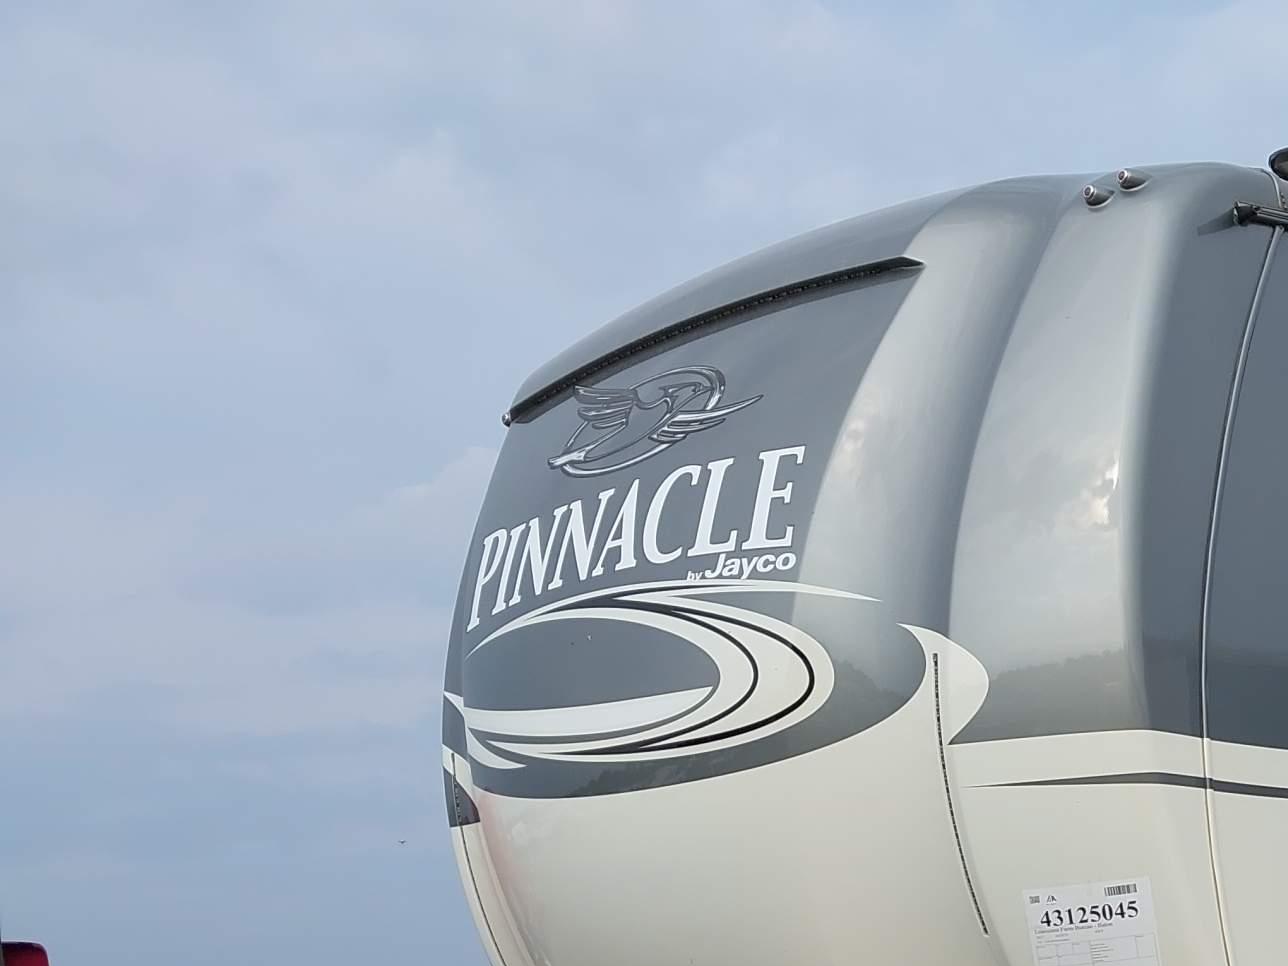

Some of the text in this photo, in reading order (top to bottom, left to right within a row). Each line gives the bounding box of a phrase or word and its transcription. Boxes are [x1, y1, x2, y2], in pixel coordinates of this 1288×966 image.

[466, 445, 807, 633] PINNACLE
[686, 552, 797, 582] by Jayco
[1040, 900, 1140, 927] 43125045
